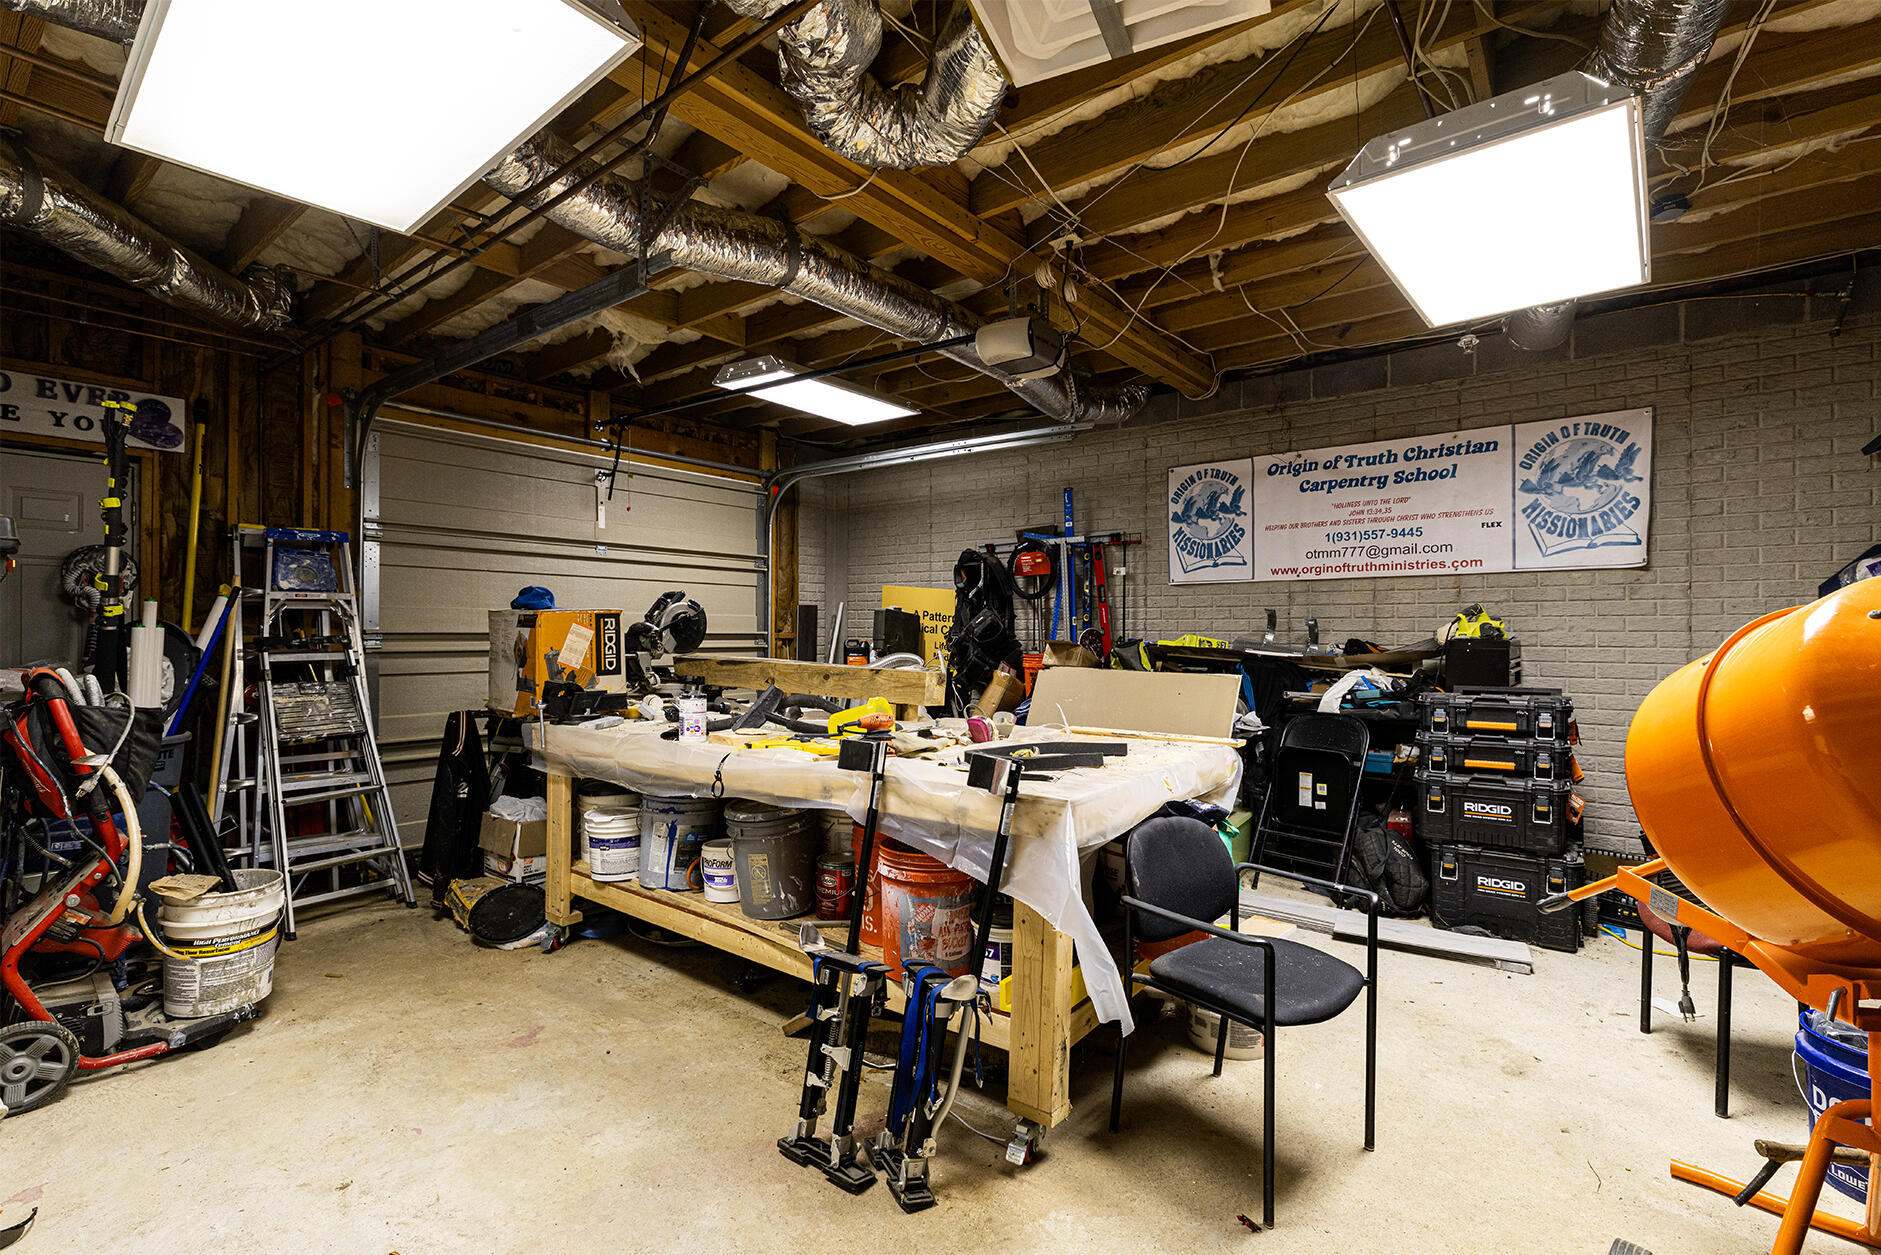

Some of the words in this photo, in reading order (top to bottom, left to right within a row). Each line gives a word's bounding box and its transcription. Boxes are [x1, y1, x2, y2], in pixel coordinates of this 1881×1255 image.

[48, 410, 105, 431] YO
[1519, 431, 1560, 470] ORIGIN
[1560, 422, 1581, 439] OF
[1584, 422, 1631, 445] TRUTH
[1267, 459, 1318, 477] Origin
[1323, 455, 1343, 470] of
[1344, 449, 1398, 468] Truth
[1403, 440, 1499, 462] Christian
[1170, 474, 1197, 505] ORIGIN
[1196, 468, 1209, 481] OF
[1210, 468, 1239, 486] TRUTH
[1299, 474, 1389, 494] Carpentry
[1393, 464, 1458, 484] School
[1363, 499, 1378, 507] UNTO
[1300, 520, 1328, 528] BROTHERS
[1343, 518, 1366, 526] SISTERS
[1521, 491, 1641, 539] MISSIONARIES
[1172, 522, 1246, 560] MISSIONARIES
[1325, 527, 1423, 544] 1(931)557-9445
[1305, 542, 1453, 560] otmm777@gmail.com
[1270, 559, 1483, 576] www.orginoftruthministries.com
[604, 618, 616, 670] RIDGID
[1464, 802, 1512, 815] RIDGID
[1477, 876, 1526, 891] RIDGID
[1831, 1164, 1868, 1190] LOWE'
